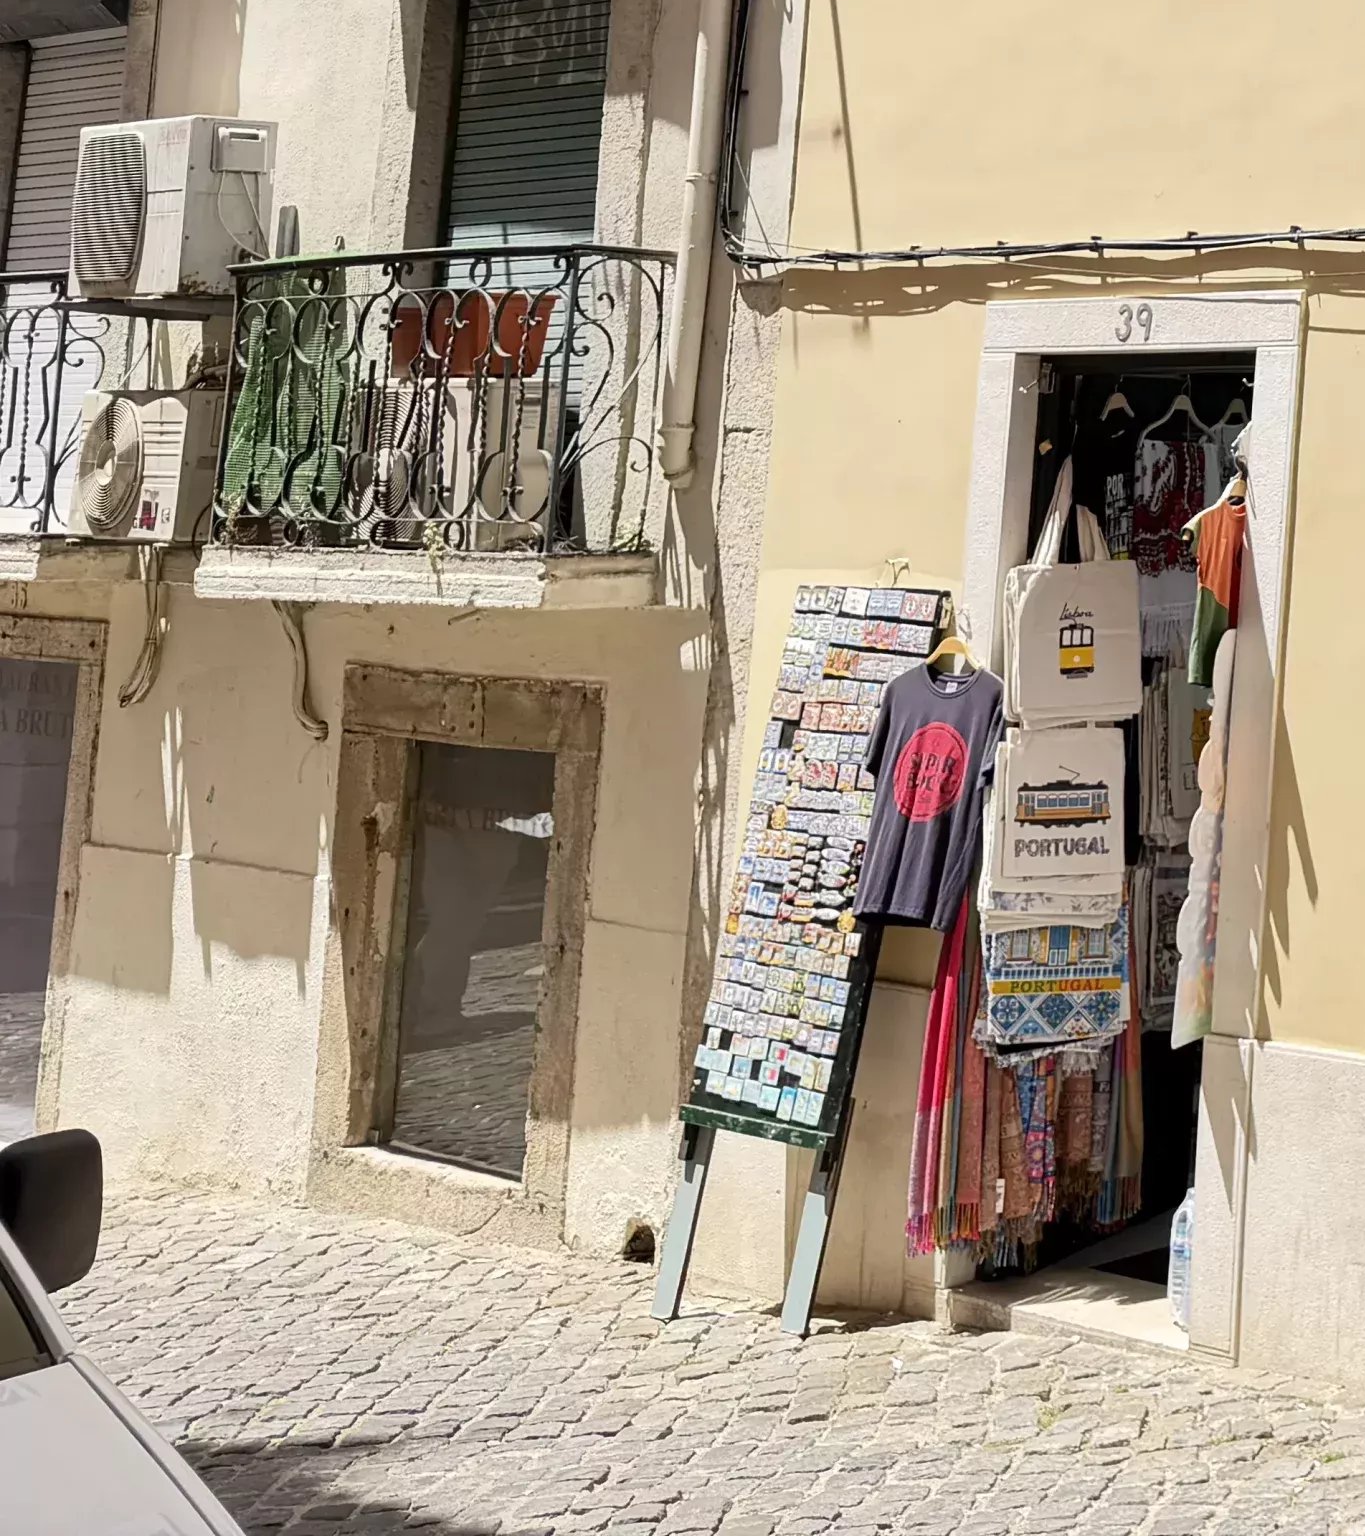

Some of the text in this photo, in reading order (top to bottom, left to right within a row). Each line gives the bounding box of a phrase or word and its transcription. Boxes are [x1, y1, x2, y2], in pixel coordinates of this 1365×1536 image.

[1115, 303, 1153, 343] 39
[1014, 836, 1110, 858] PORTUGAL
[1010, 978, 1105, 993] PORTUGAL
